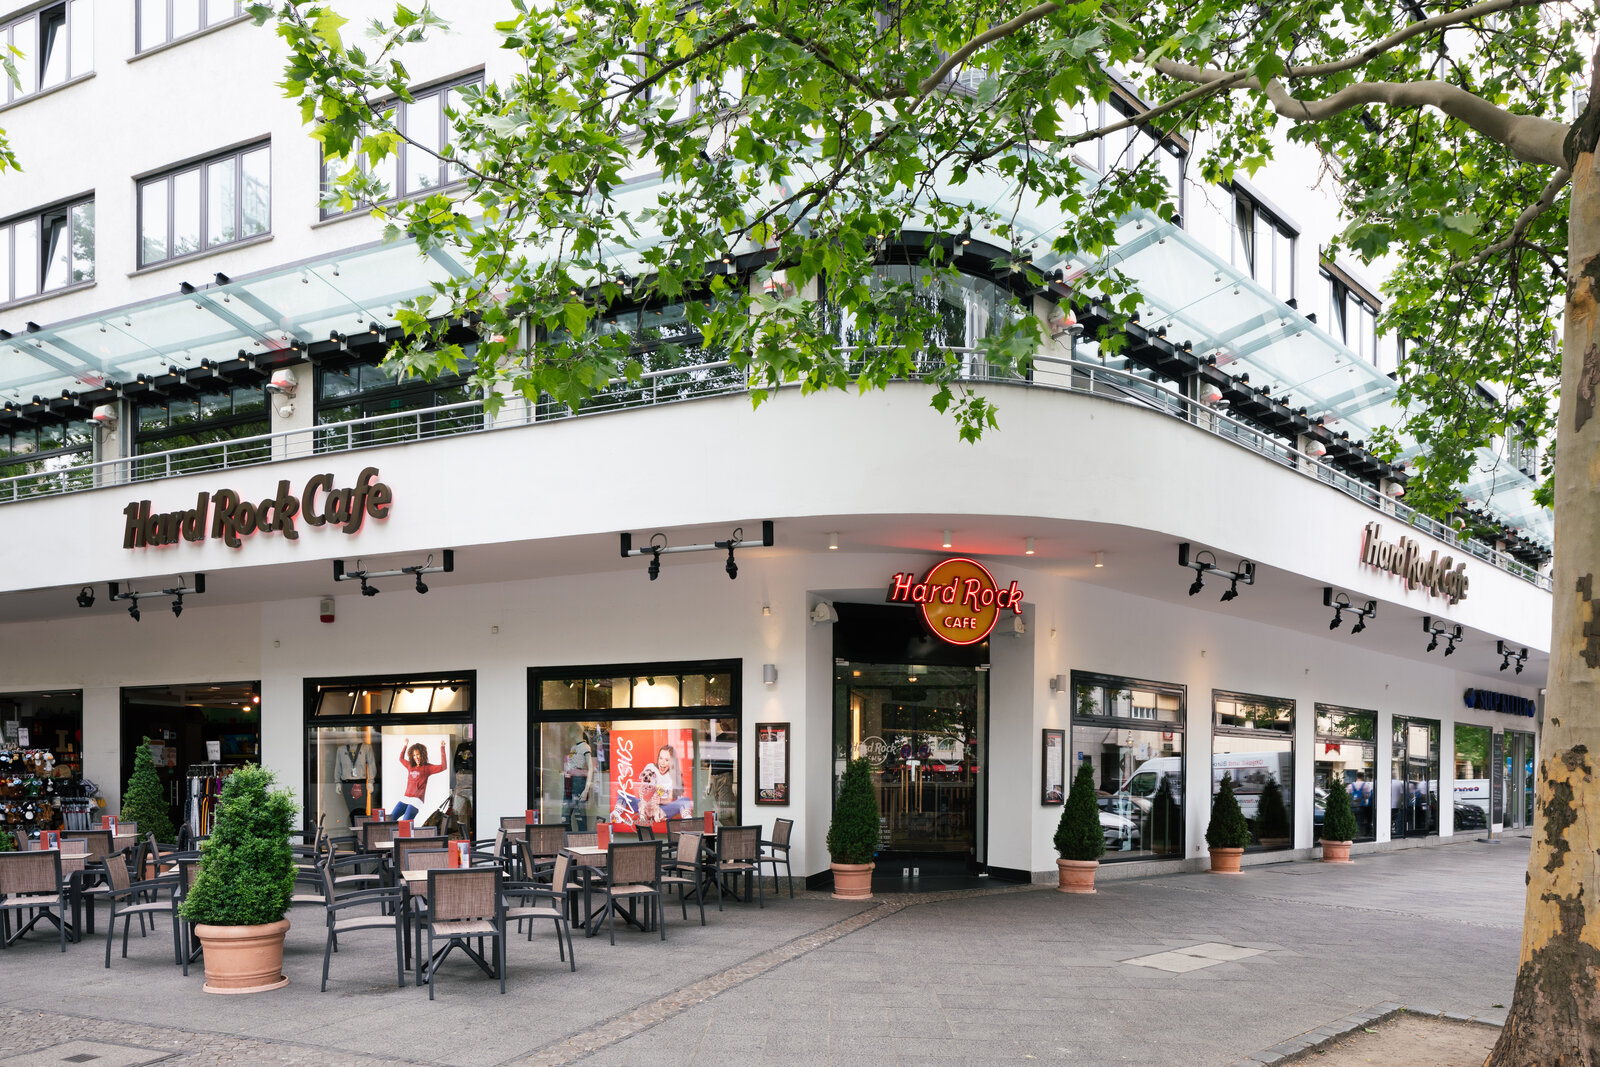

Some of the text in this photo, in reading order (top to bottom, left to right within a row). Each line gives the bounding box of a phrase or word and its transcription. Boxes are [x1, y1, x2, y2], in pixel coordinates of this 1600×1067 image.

[123, 466, 392, 549] Hard Rock Cafe
[892, 573, 1024, 614] Hard Rock
[1362, 521, 1469, 605] Hard Rock Cafe
[943, 616, 977, 629] CAFE
[875, 742, 897, 755] Rock
[616, 736, 636, 826] CLASSICS
